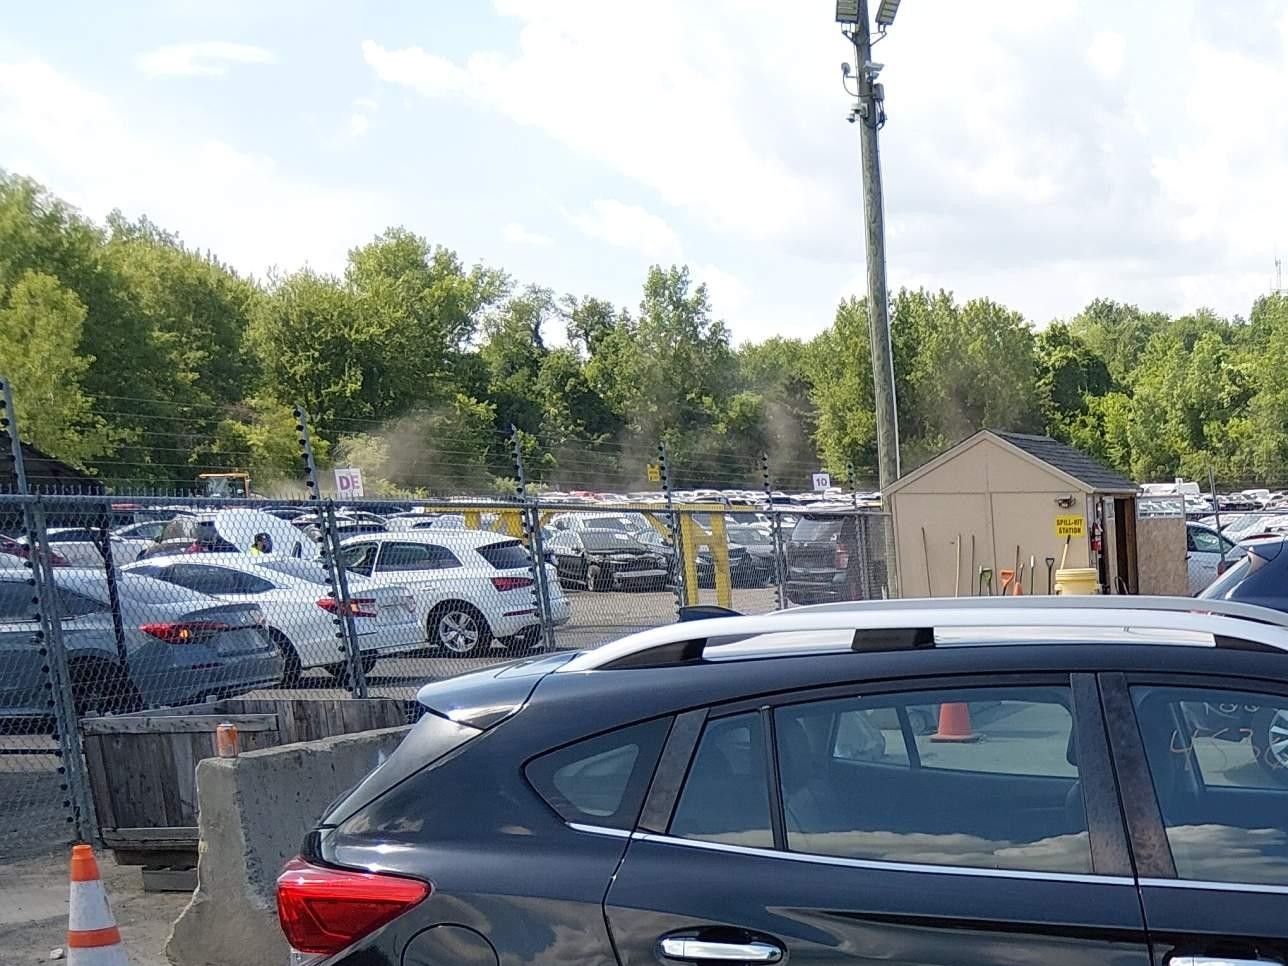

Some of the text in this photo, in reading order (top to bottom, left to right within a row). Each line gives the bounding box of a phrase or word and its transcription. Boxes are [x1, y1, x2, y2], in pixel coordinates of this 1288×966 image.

[338, 474, 361, 490] DE
[815, 477, 828, 487] 10
[1056, 518, 1083, 527] SPILL-KIT
